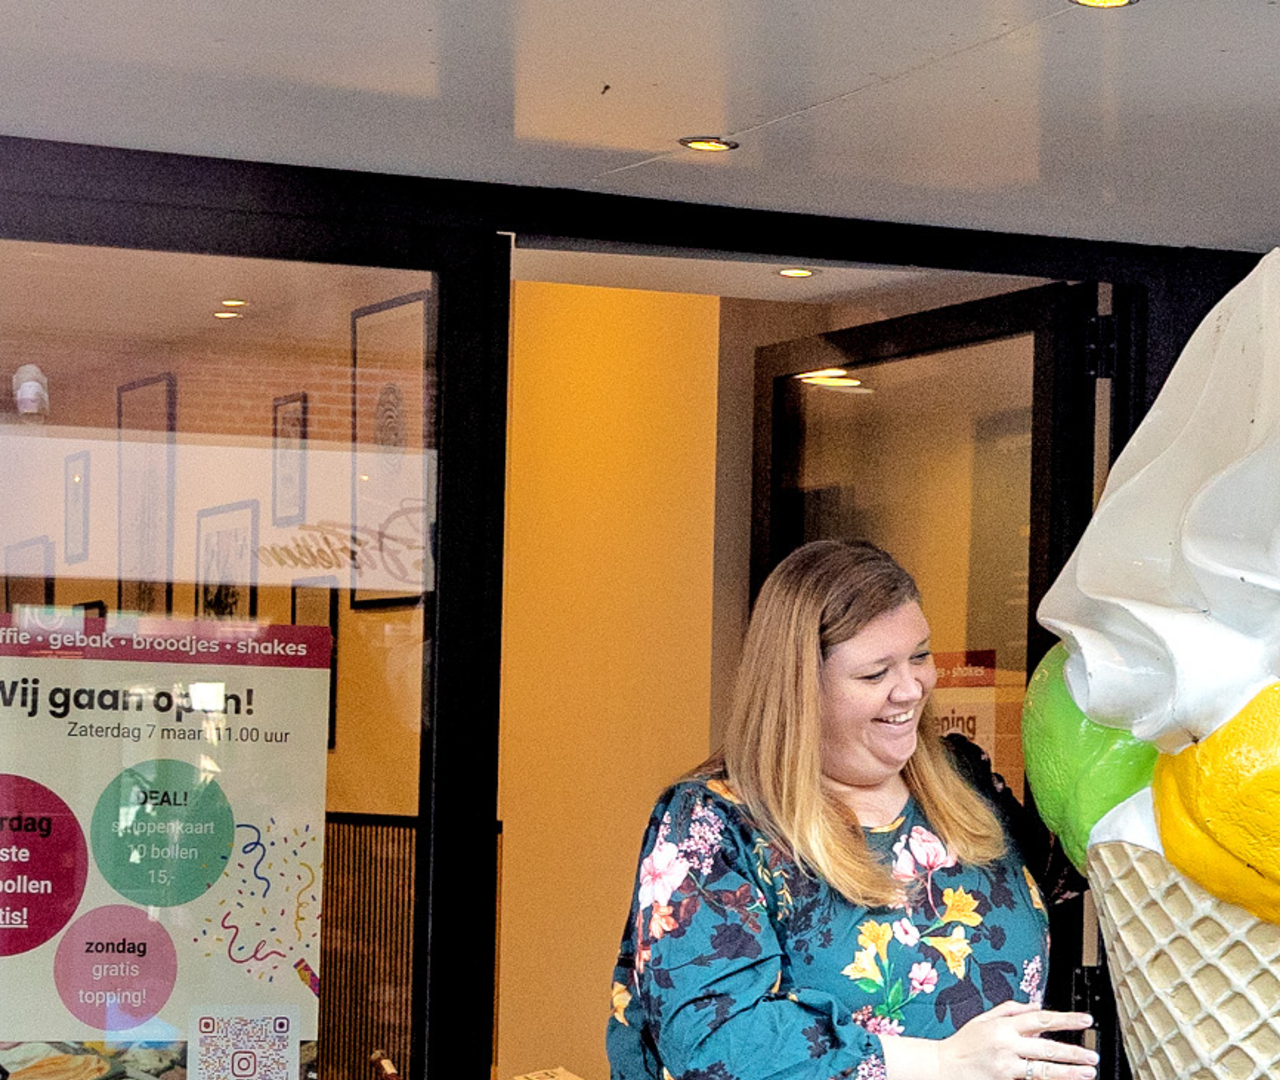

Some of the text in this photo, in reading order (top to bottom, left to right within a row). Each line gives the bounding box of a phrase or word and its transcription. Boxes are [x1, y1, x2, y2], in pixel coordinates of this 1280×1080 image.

[48, 630, 114, 650] gebak
[132, 633, 219, 654] broodjes
[237, 639, 308, 657] shakes
[48, 686, 144, 719] gaan
[67, 721, 142, 742] Zaterdag
[146, 724, 157, 740] 7
[263, 730, 290, 743] uur
[136, 790, 188, 807] DEAL!
[151, 844, 198, 860] bollen
[148, 870, 176, 884] 15,-
[85, 938, 147, 957] zondag
[92, 961, 140, 980] gratis
[78, 988, 146, 1007] topping!
